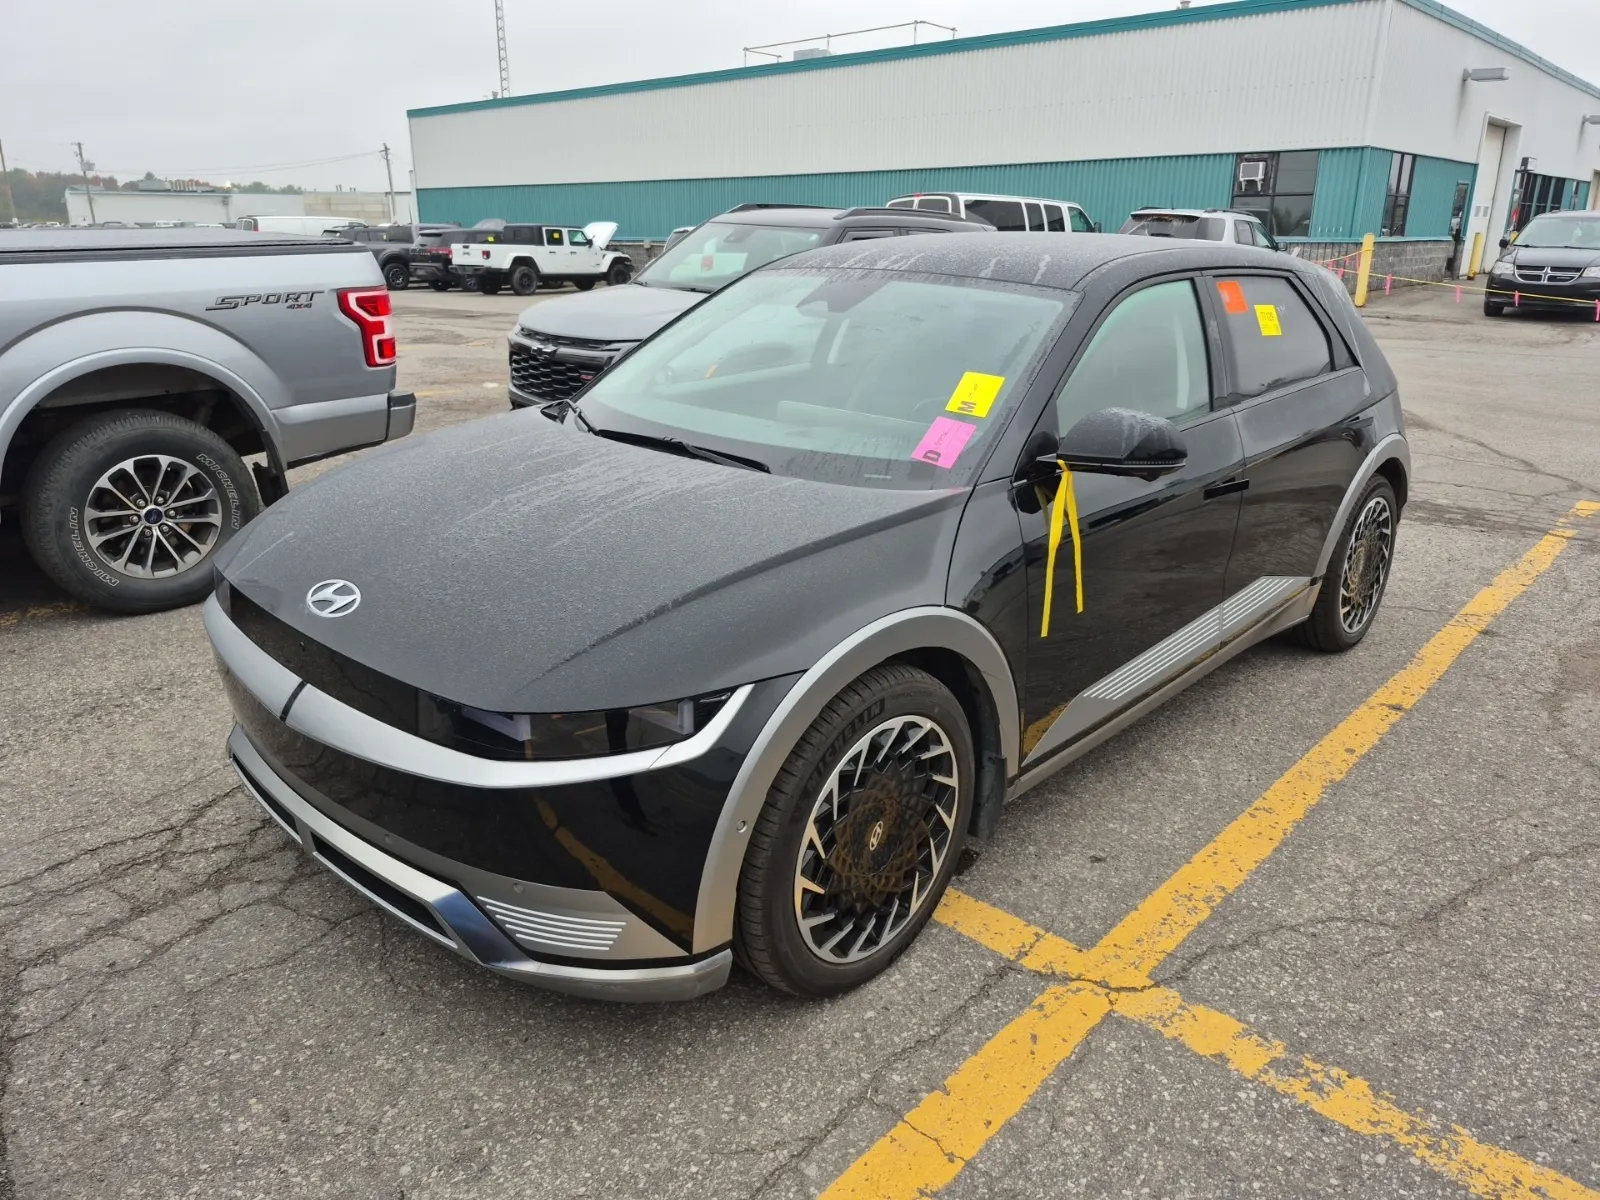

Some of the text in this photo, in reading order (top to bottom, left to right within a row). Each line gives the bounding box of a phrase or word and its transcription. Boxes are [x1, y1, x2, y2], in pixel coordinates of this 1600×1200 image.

[205, 291, 325, 311] SPORT
[957, 401, 976, 412] M
[923, 450, 941, 463] D
[196, 453, 242, 530] MICHELIN
[68, 506, 120, 588] MICHELIN
[807, 700, 883, 791] MICHELIN
